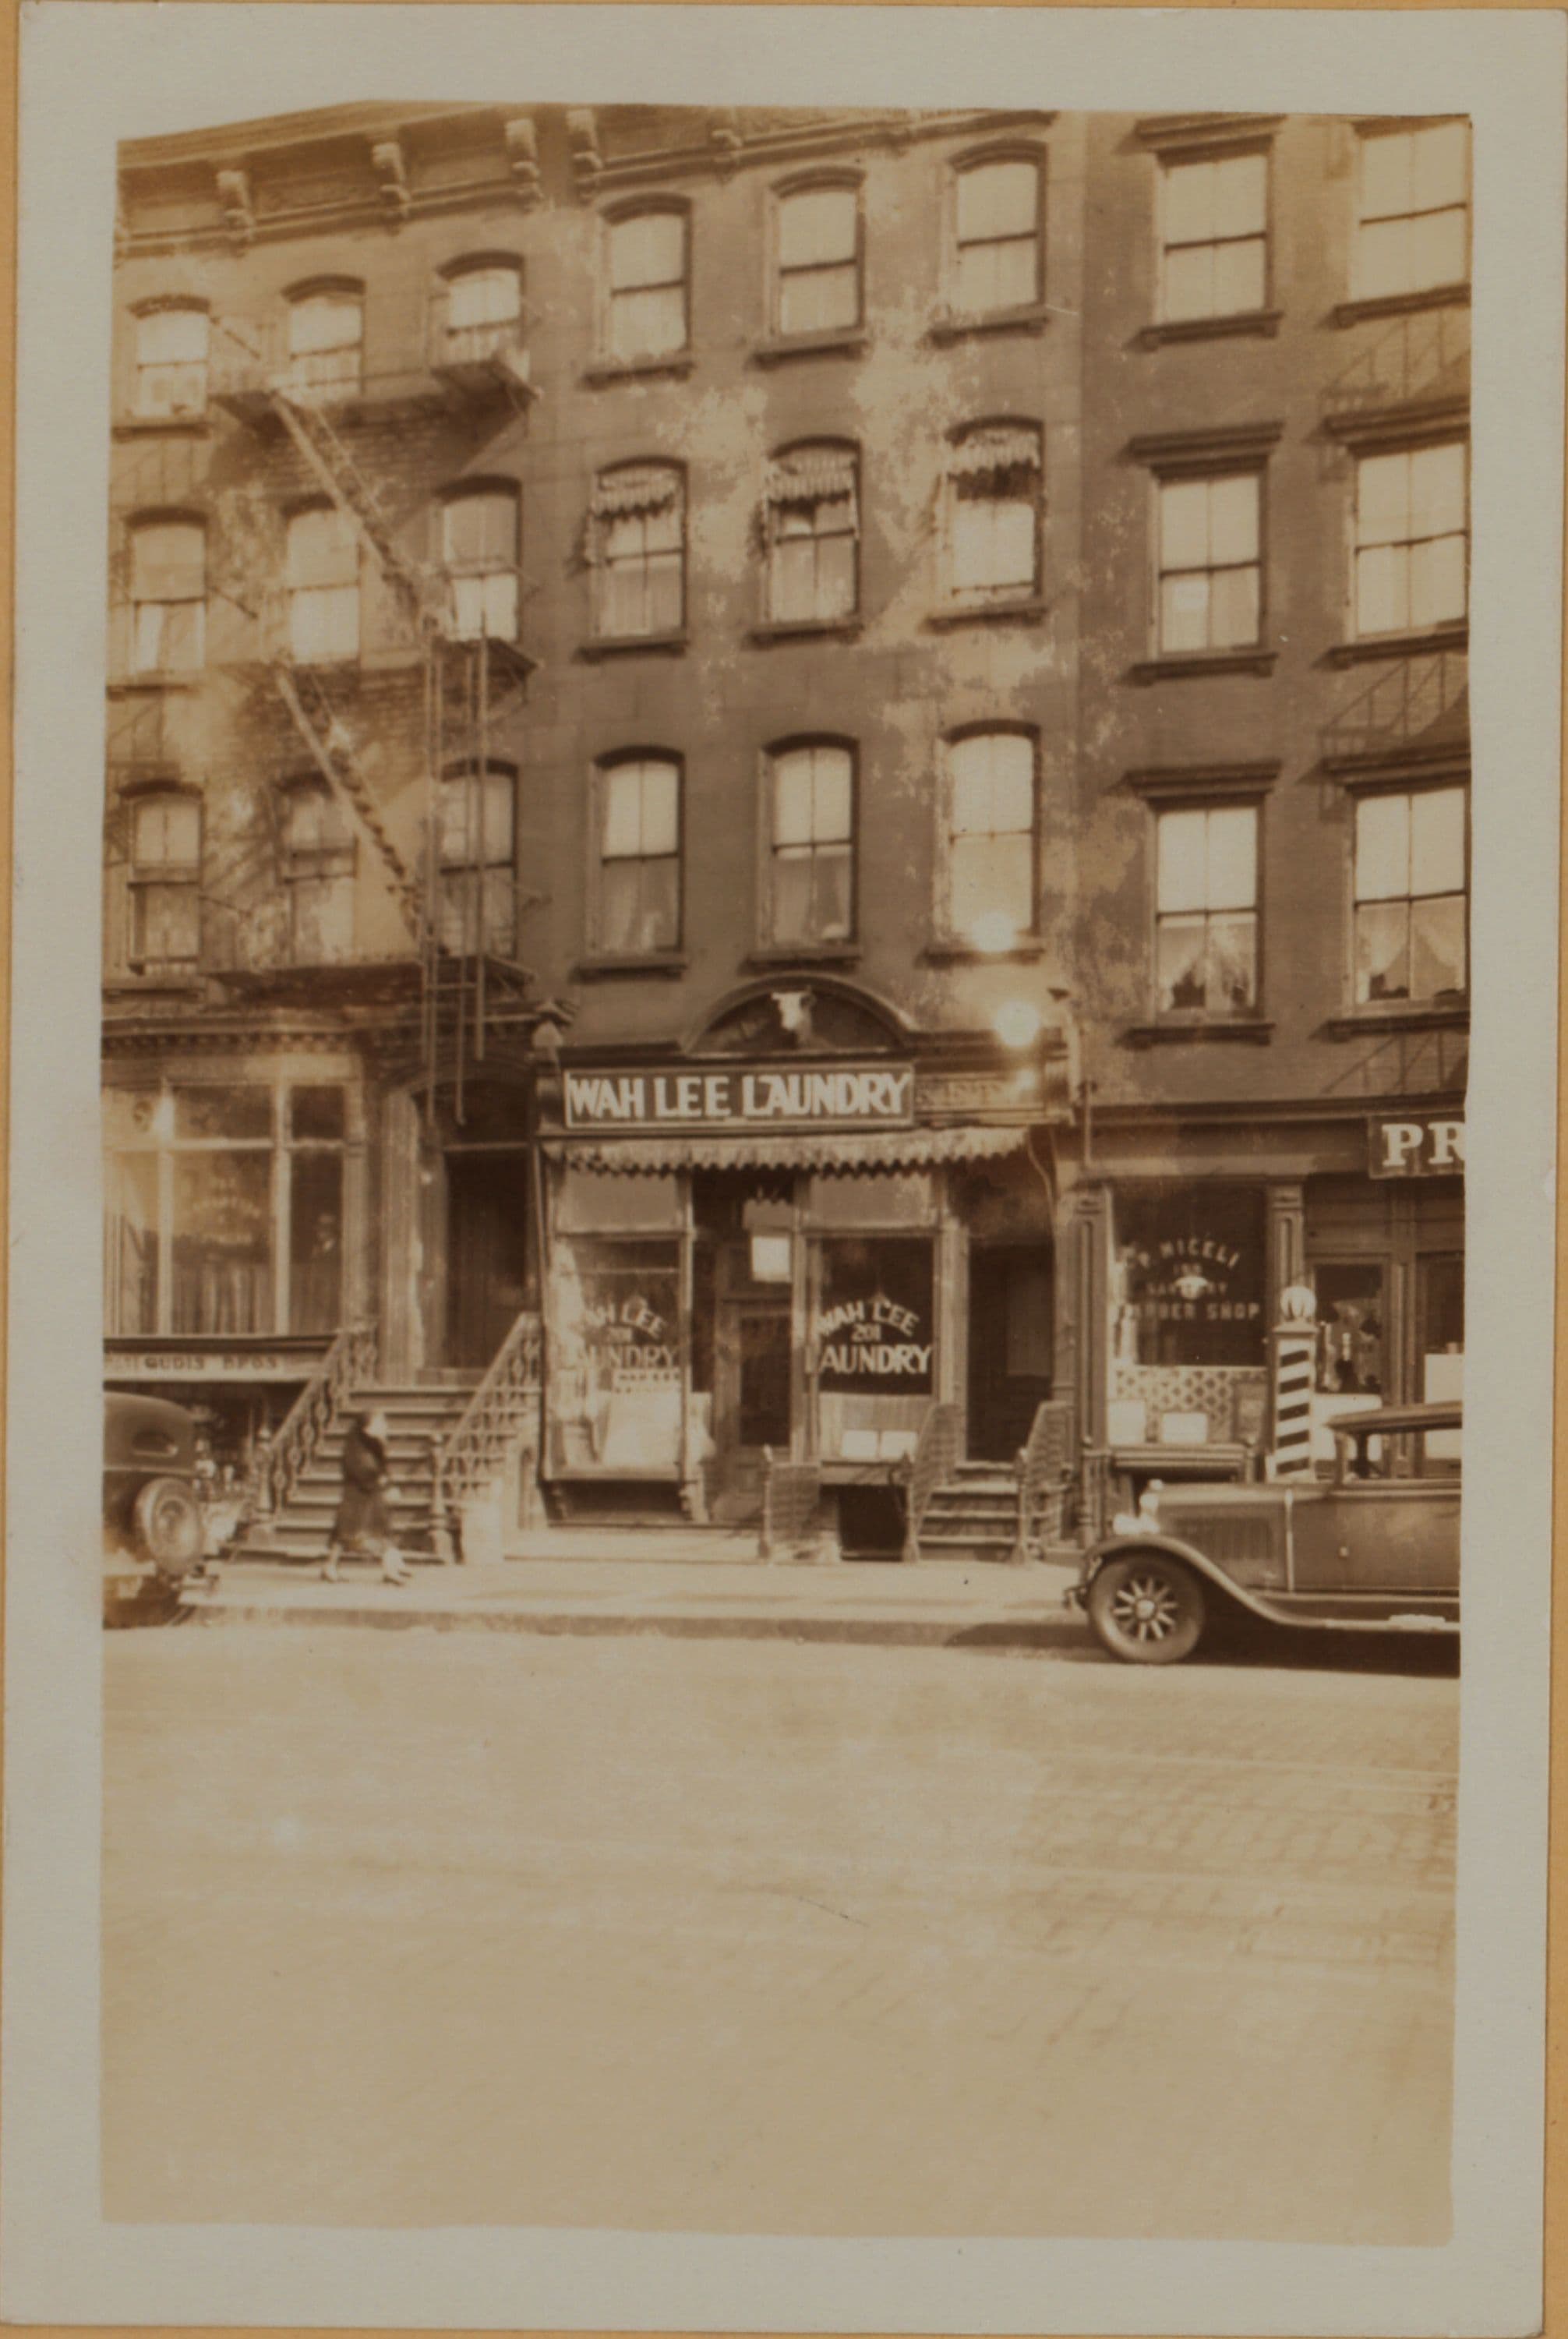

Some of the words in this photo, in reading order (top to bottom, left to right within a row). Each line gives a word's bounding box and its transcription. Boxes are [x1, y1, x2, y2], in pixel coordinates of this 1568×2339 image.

[570, 1077, 645, 1118] WAH
[655, 1076, 731, 1117] LEE
[742, 1072, 913, 1116] LAUNDRY
[1382, 1121, 1465, 1167] PR
[871, 1299, 921, 1338] LEE
[1207, 1302, 1259, 1320] SHOP
